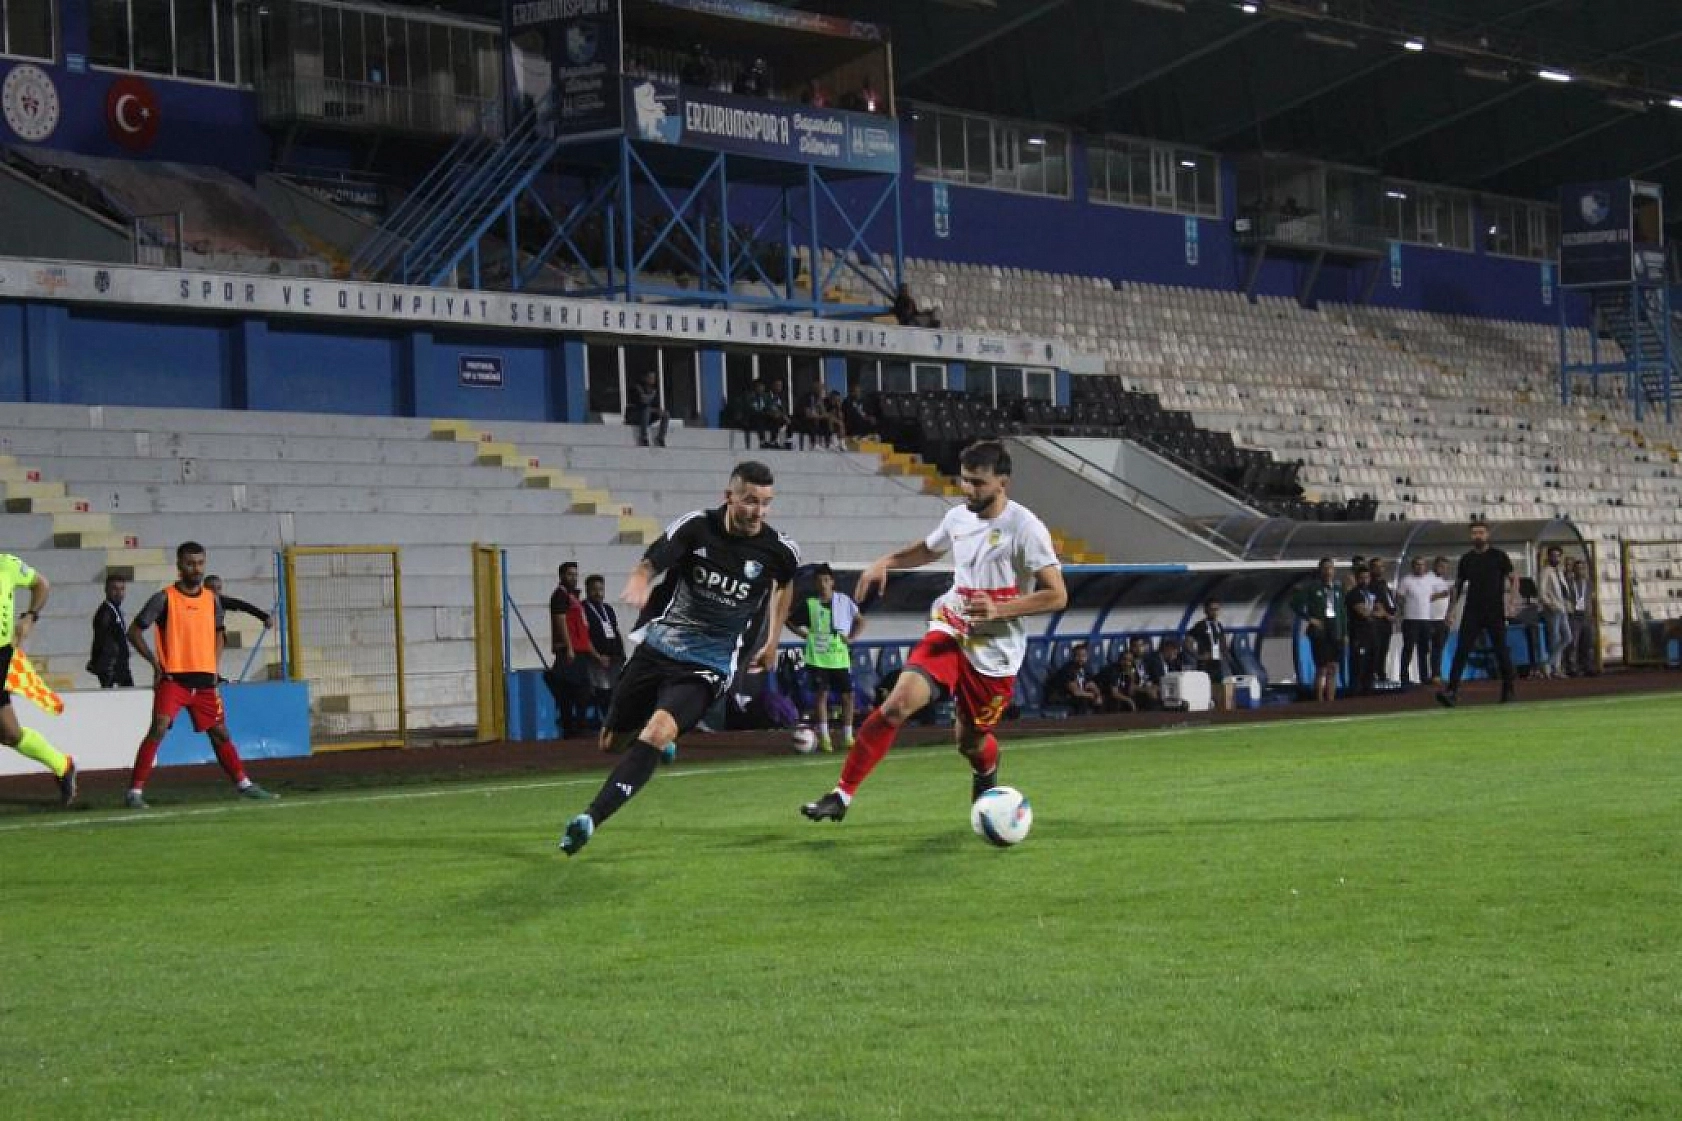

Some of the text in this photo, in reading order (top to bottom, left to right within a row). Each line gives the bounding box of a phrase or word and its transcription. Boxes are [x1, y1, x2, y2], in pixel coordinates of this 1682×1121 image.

[180, 280, 255, 302] SPOR
[282, 286, 311, 307] VE
[694, 566, 752, 600] OPUS
